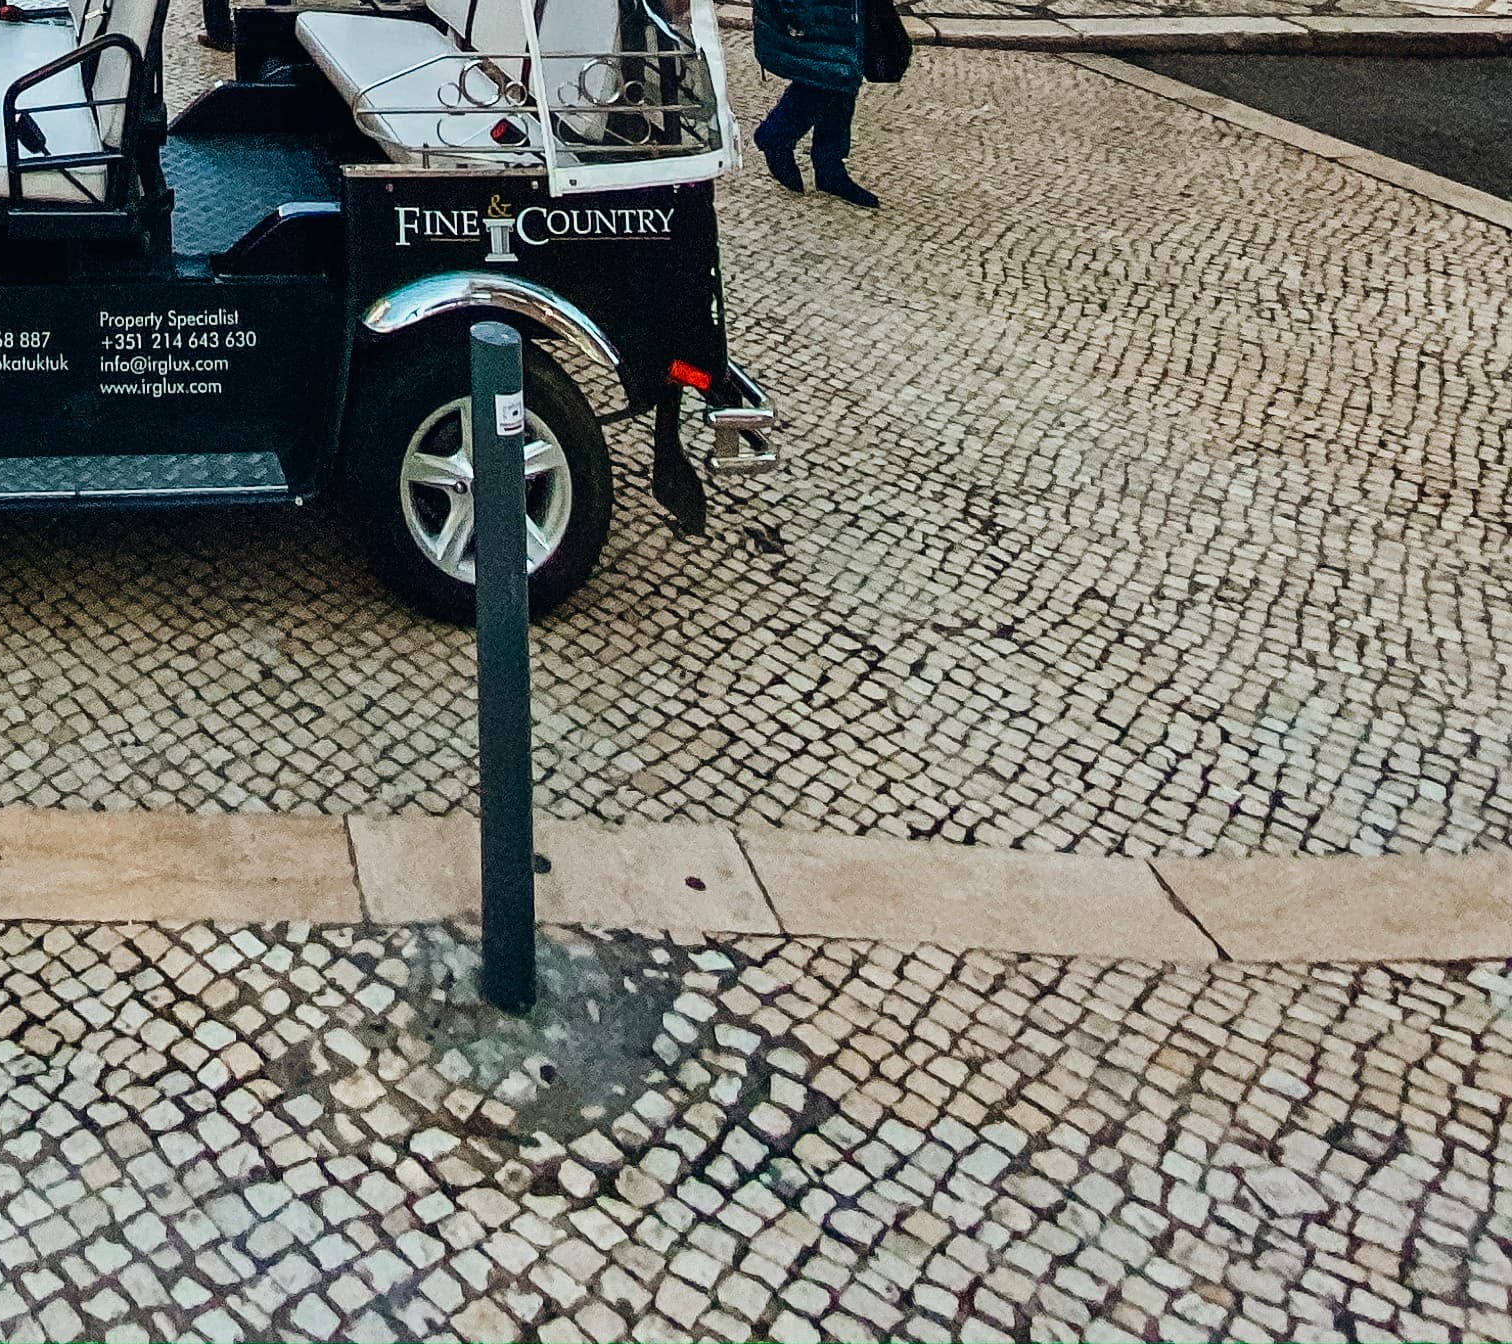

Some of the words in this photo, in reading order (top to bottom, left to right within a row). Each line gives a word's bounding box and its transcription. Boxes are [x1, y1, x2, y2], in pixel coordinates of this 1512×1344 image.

[394, 206, 481, 246] FINE
[516, 206, 675, 246] COUNTRY
[99, 311, 163, 331] Property
[167, 308, 239, 331] Specialist
[19, 331, 51, 348] 887
[101, 332, 143, 350] +351
[151, 332, 183, 349] 214
[188, 331, 220, 349] 643
[225, 331, 257, 348] 630
[100, 353, 229, 375] info@irglux.com
[100, 377, 223, 398] www.irglux.com
